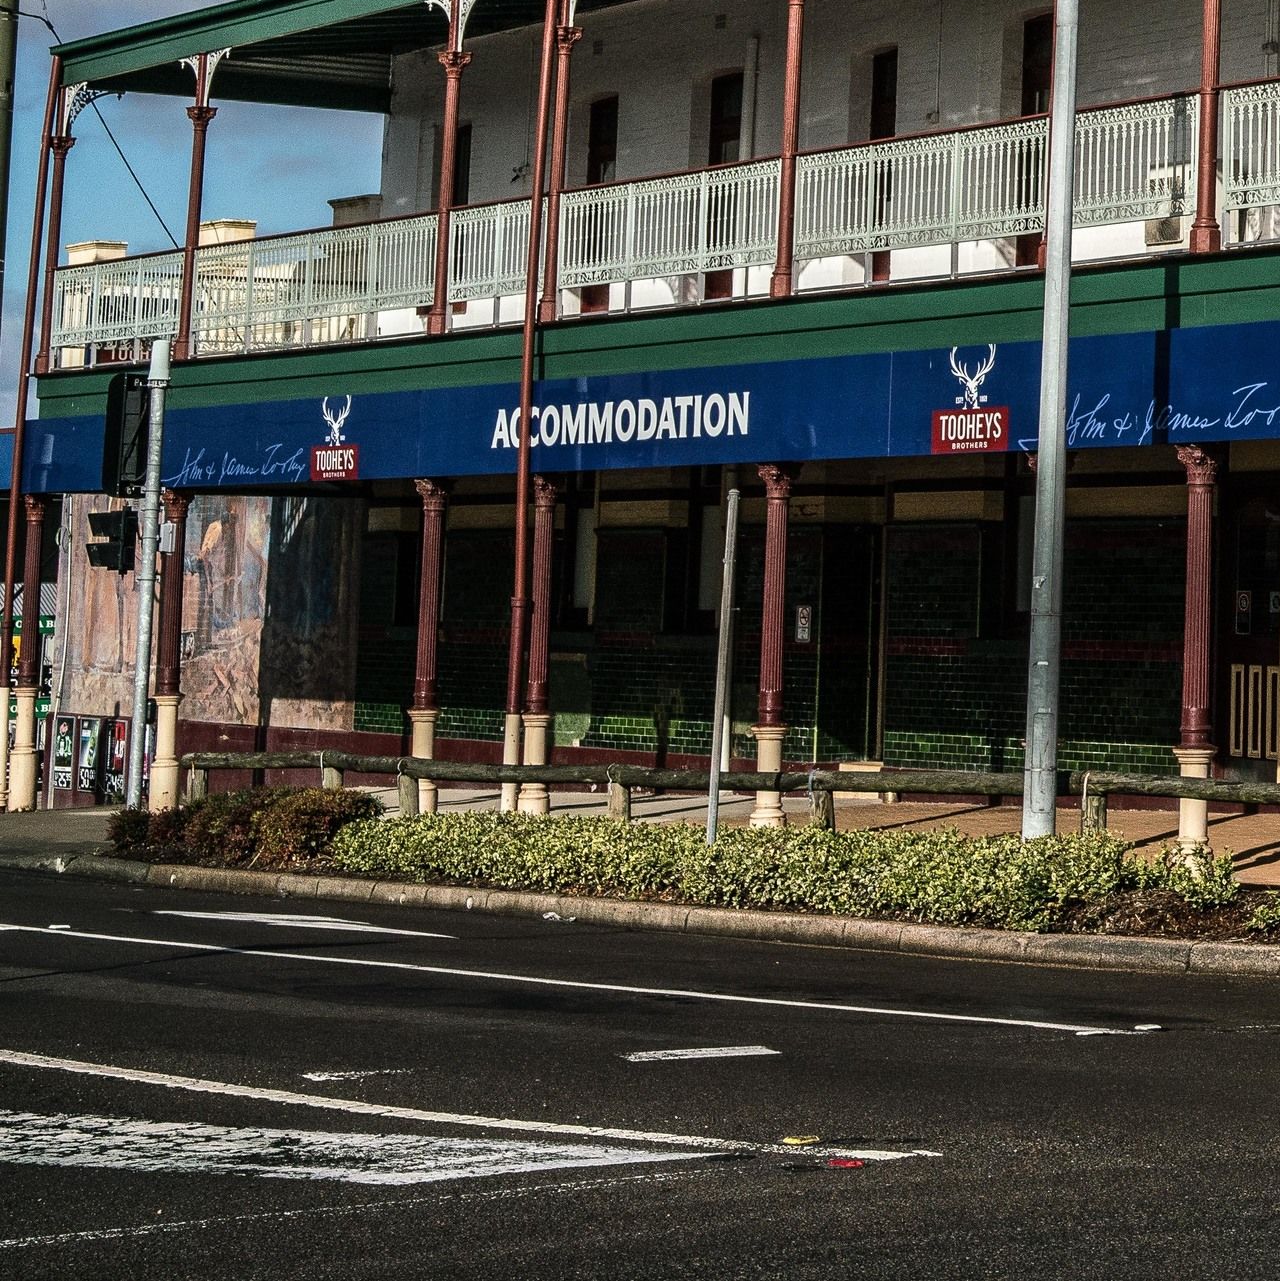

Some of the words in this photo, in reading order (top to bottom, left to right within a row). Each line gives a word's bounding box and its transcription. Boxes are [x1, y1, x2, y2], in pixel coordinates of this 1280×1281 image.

[940, 411, 1003, 442] TOOHEYS
[1137, 399, 1221, 446] James
[314, 448, 355, 472] TOOHEYS
[951, 441, 989, 451] BROTHERS
[218, 451, 260, 486] James
